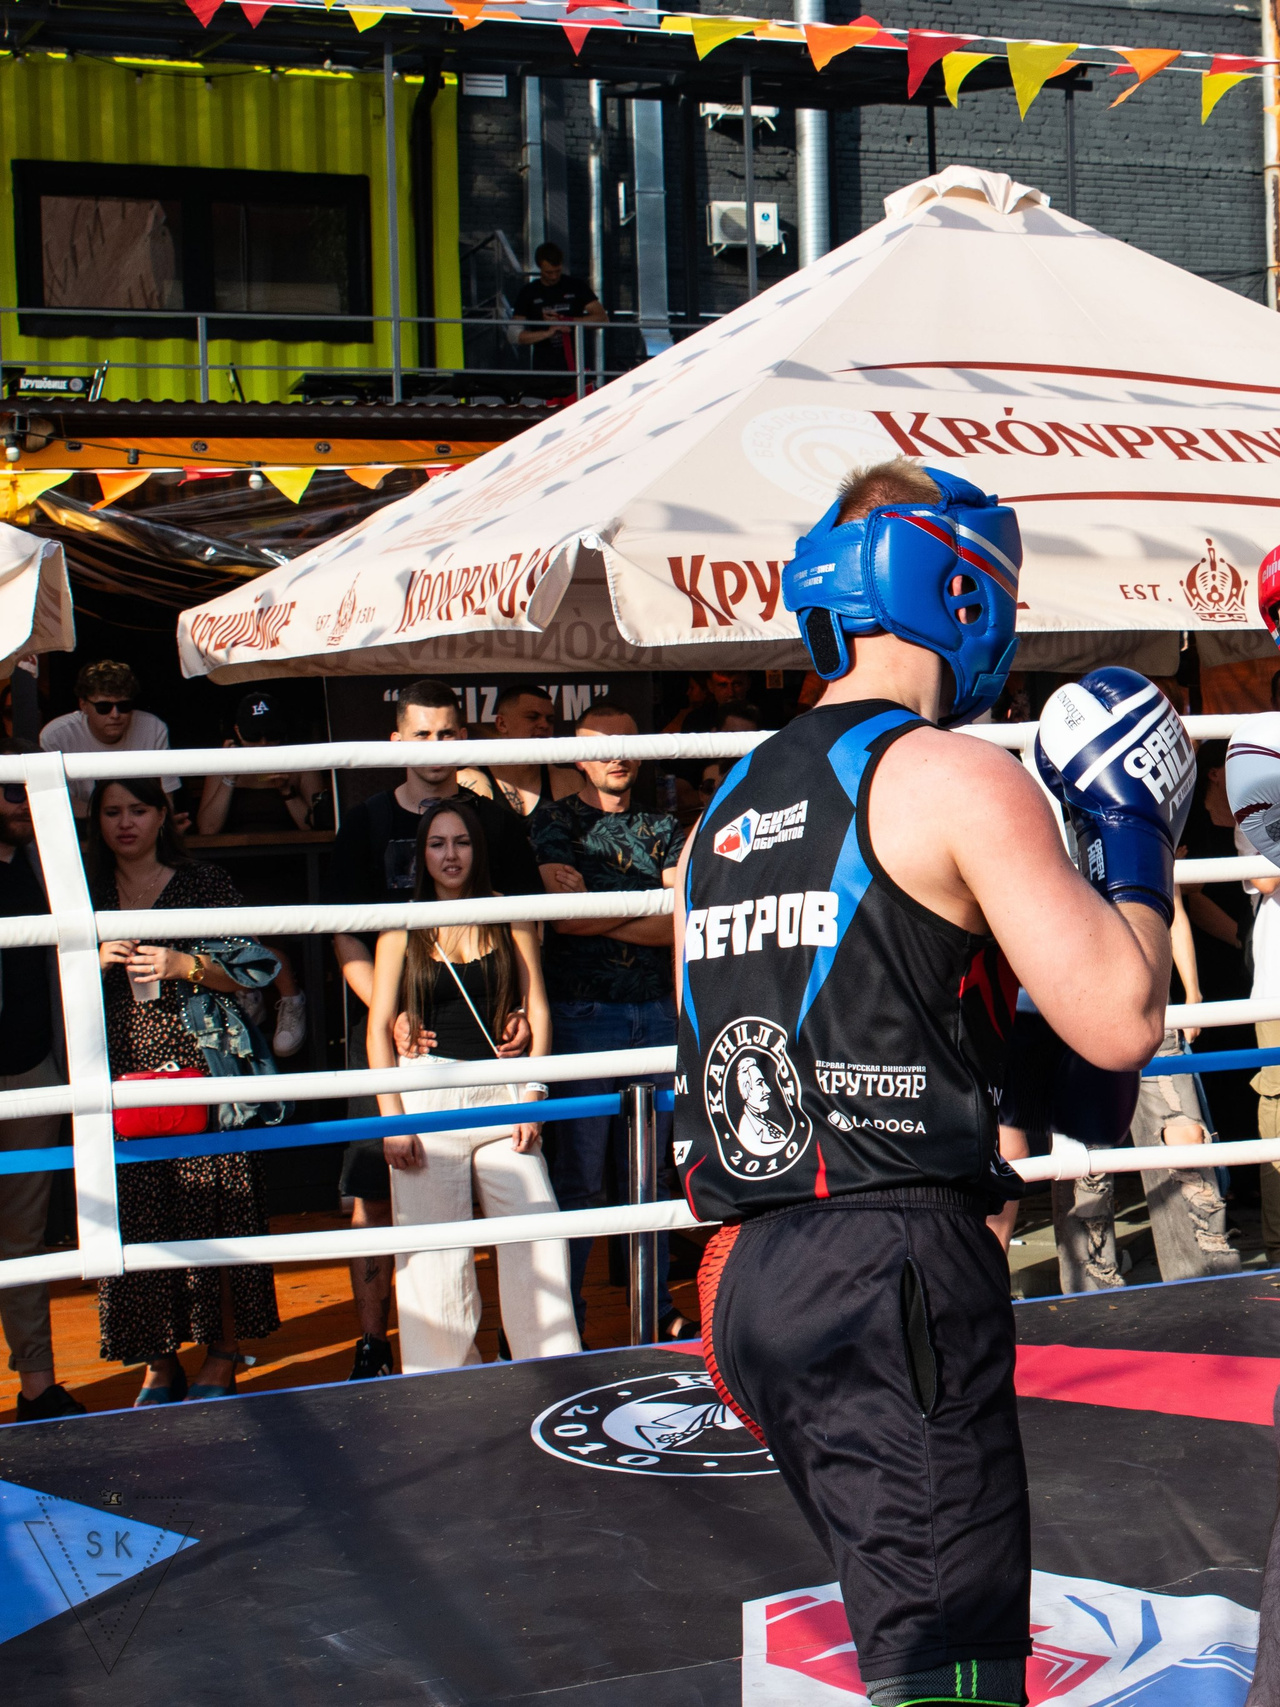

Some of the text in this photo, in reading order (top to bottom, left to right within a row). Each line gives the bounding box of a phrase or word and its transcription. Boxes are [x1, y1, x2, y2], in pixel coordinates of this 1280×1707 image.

[1119, 584, 1172, 603] EST.
[1123, 708, 1184, 779] GREE
[1141, 731, 1195, 805] HILL
[1087, 843, 1098, 881] HILL
[1094, 838, 1106, 881] GREEN
[685, 890, 839, 963] ВЕТРОВ
[815, 1060, 846, 1070] ПЕРВАЯ
[847, 1063, 880, 1072] РУССКАЯ
[815, 1069, 927, 1099] КРУТОЯР
[852, 1115, 927, 1135] LADOGA
[730, 1141, 799, 1173] 2010
